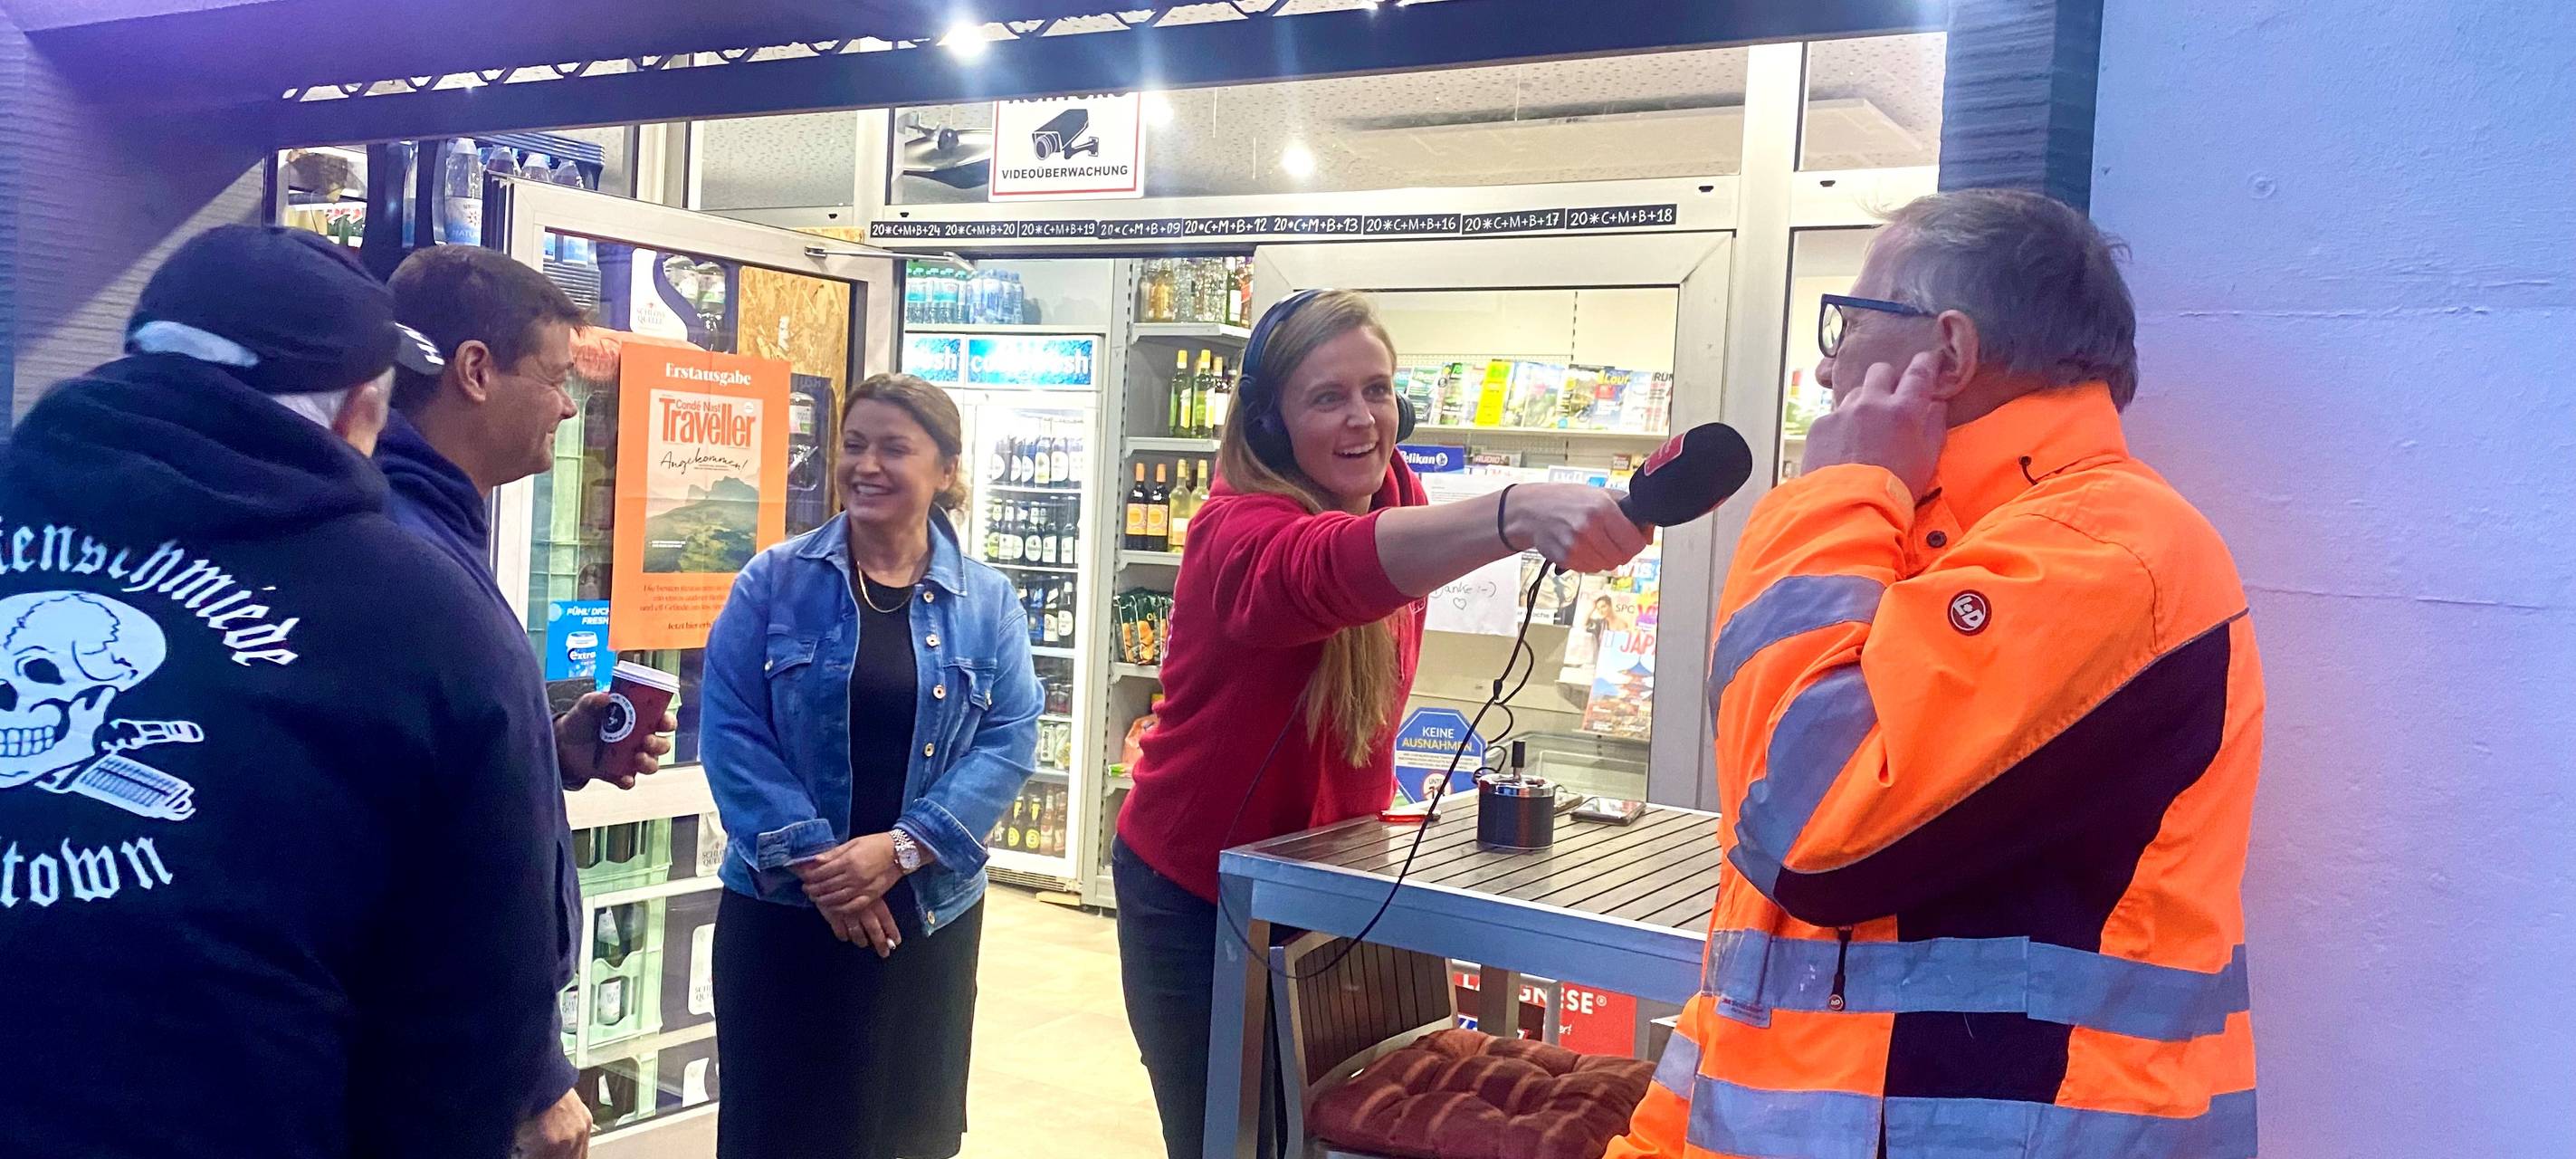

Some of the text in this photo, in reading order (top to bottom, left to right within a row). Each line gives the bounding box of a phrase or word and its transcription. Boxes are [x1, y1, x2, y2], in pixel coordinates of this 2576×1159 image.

[1002, 165, 1128, 179] VIDEOÜBERWACHUNG
[665, 362, 751, 386] Erstausgabe
[676, 399, 720, 413] Condé Nast
[659, 398, 756, 446] Traveller
[0, 516, 300, 666] enschmiede
[1422, 726, 1455, 739] KEINE
